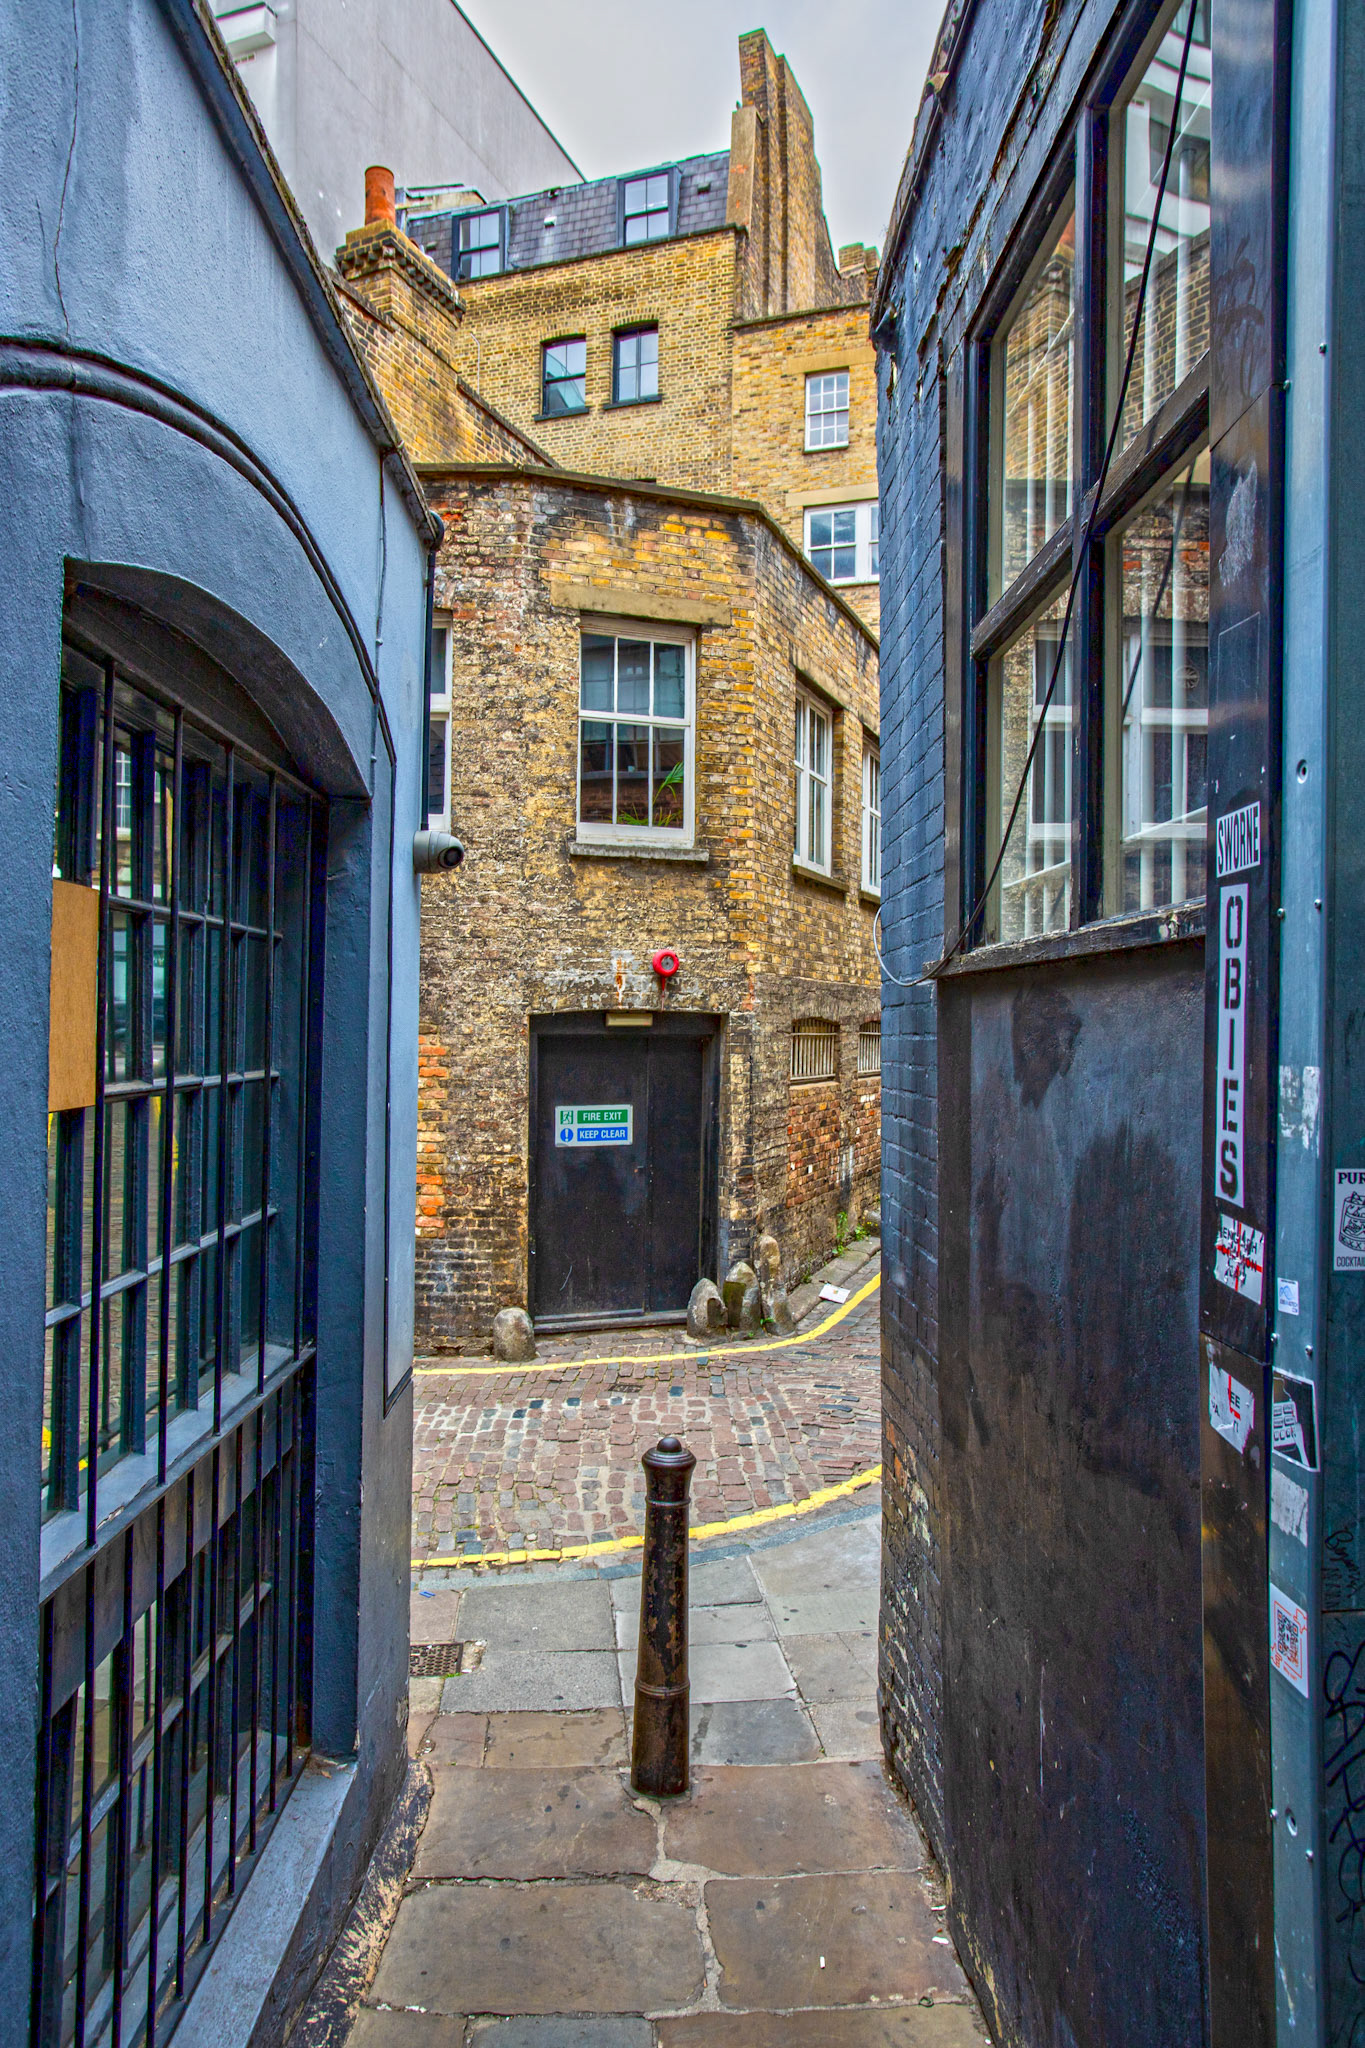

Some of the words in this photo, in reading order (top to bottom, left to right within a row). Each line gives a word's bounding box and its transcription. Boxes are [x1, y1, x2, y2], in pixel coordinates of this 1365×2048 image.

[1217, 805, 1259, 875] SWORNE
[1220, 895, 1243, 1199] OBIES
[580, 1130, 599, 1139] KEEP
[601, 1129, 625, 1138] CLEAR
[583, 1112, 601, 1121] FIRE
[604, 1111, 622, 1120] EXIT
